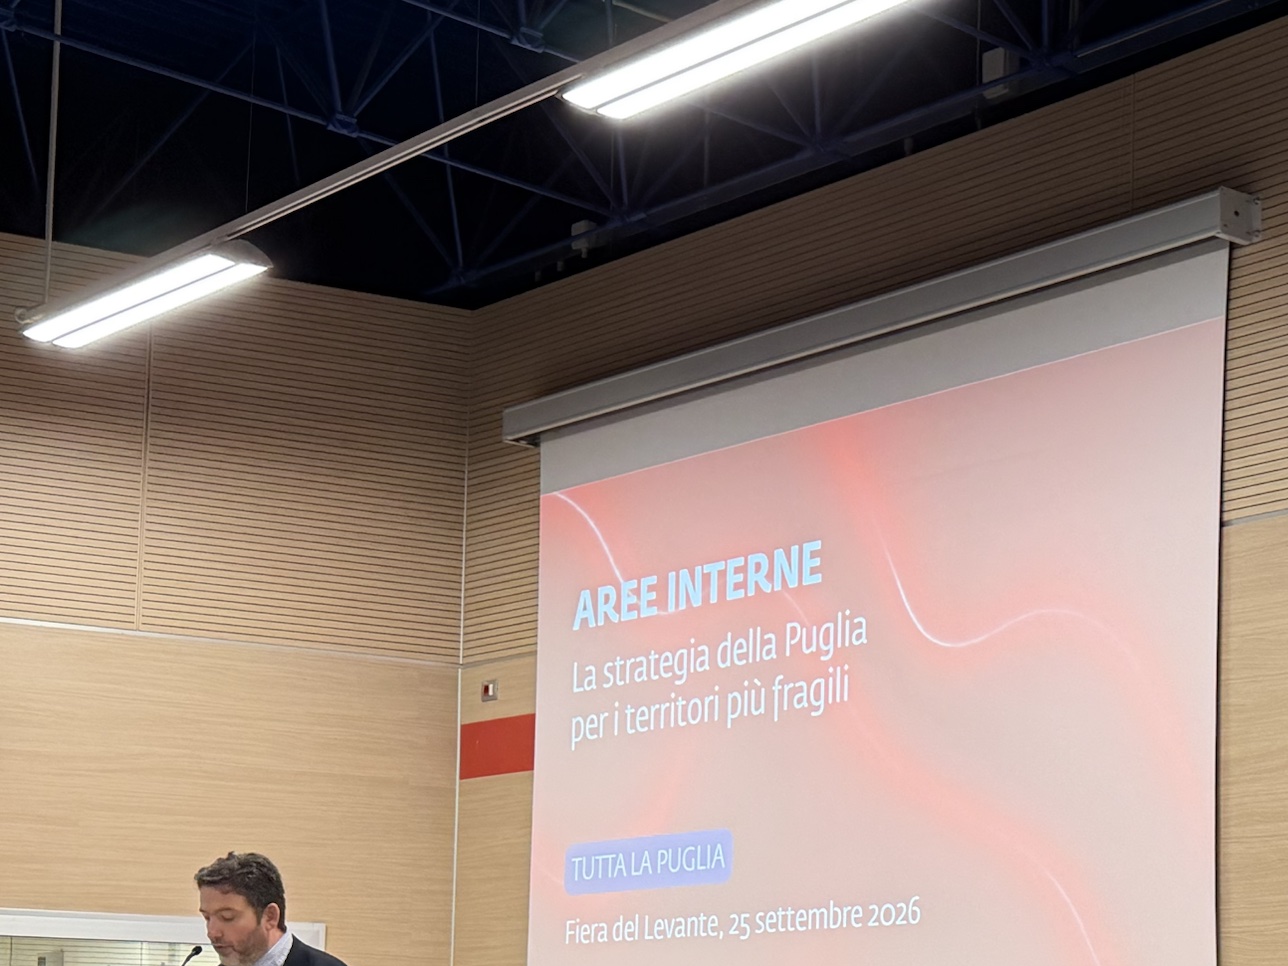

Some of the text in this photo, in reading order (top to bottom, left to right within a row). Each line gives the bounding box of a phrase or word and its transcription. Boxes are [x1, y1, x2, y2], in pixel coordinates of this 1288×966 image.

[573, 539, 823, 631] AREE INTERNE
[572, 609, 868, 693] La strategia della Puglia
[570, 664, 850, 750] per i territori più fragili
[571, 843, 726, 882] TUTTA LA PUGLIA
[565, 896, 922, 944] Fiera del Levante, 25 settembre 2026
